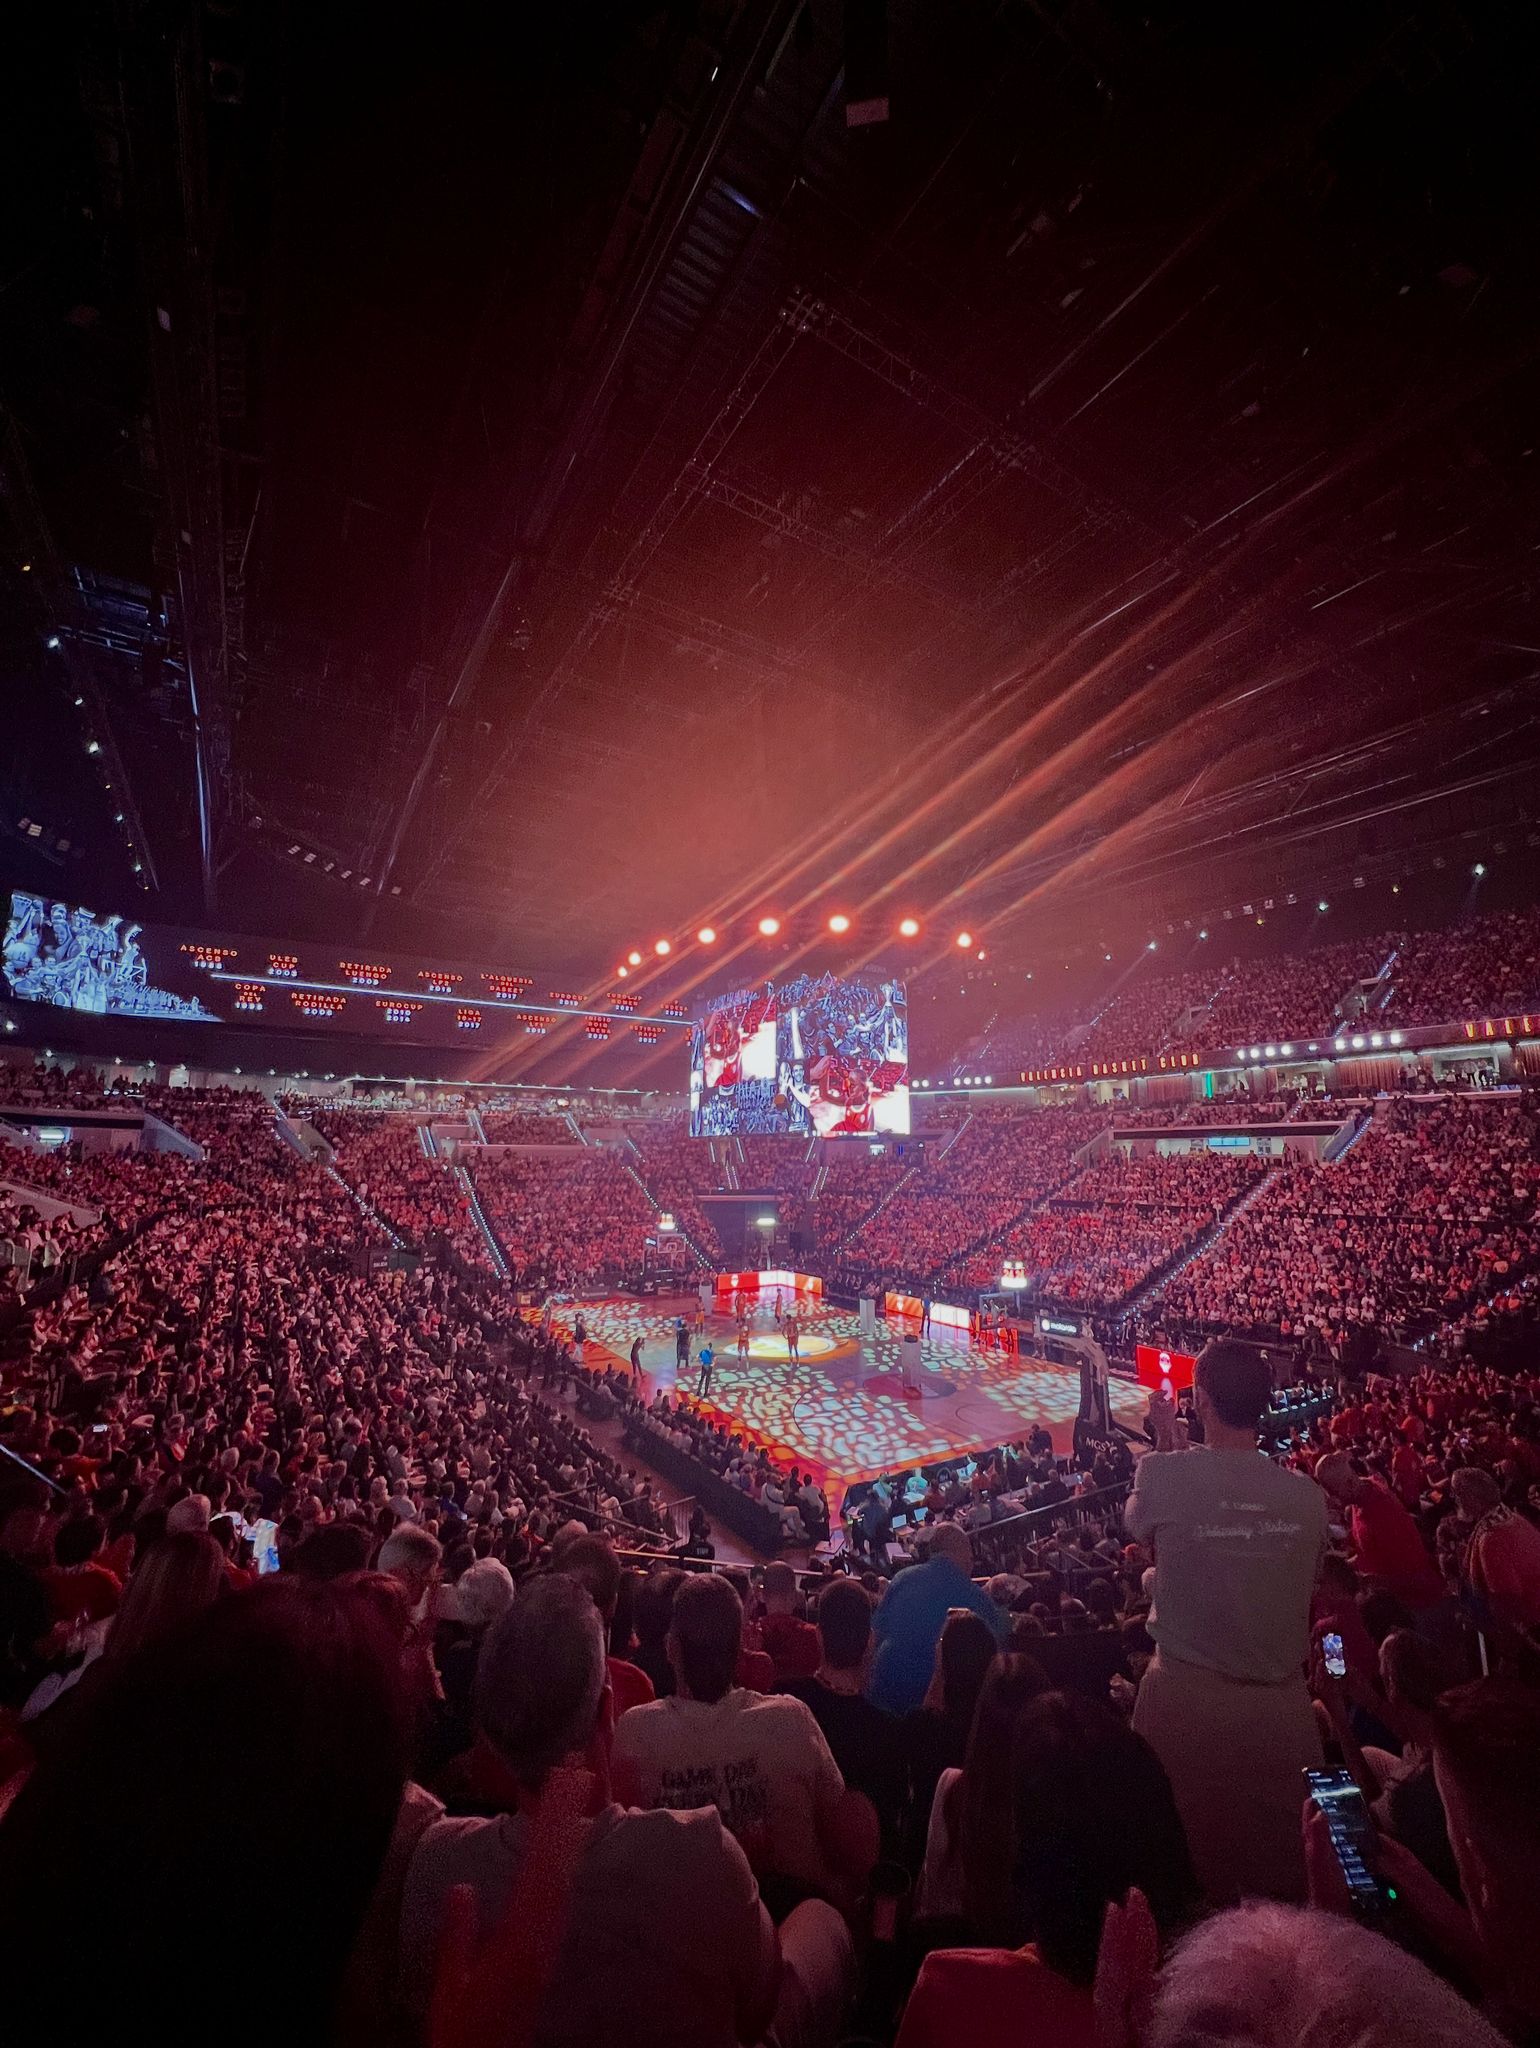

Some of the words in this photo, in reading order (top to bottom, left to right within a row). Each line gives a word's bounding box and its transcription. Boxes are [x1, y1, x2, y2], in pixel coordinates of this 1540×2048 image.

[180, 944, 238, 957] ASCENSO
[197, 954, 222, 962] ACB
[269, 954, 298, 963] ULEB
[340, 961, 392, 974] RETIRADA
[345, 969, 388, 980] LUENGO
[417, 970, 463, 982] ASCENSO
[234, 983, 266, 992] COPA
[239, 995, 262, 1003] REY
[291, 992, 347, 1004] RETIRADA
[496, 992, 518, 1000] 2017
[549, 992, 588, 1001] EUROCUP
[295, 1000, 344, 1010] RODILLA
[375, 1000, 423, 1011] EUROCUP
[458, 1008, 481, 1016] LIGA
[516, 1014, 557, 1023] ASCENSO
[458, 1021, 481, 1029] 2017
[1020, 1066, 1082, 1082] VALENCIA
[1093, 1058, 1147, 1075] BASKET
[1160, 1053, 1199, 1069] CLUB
[1085, 1436, 1106, 1452] MGS
